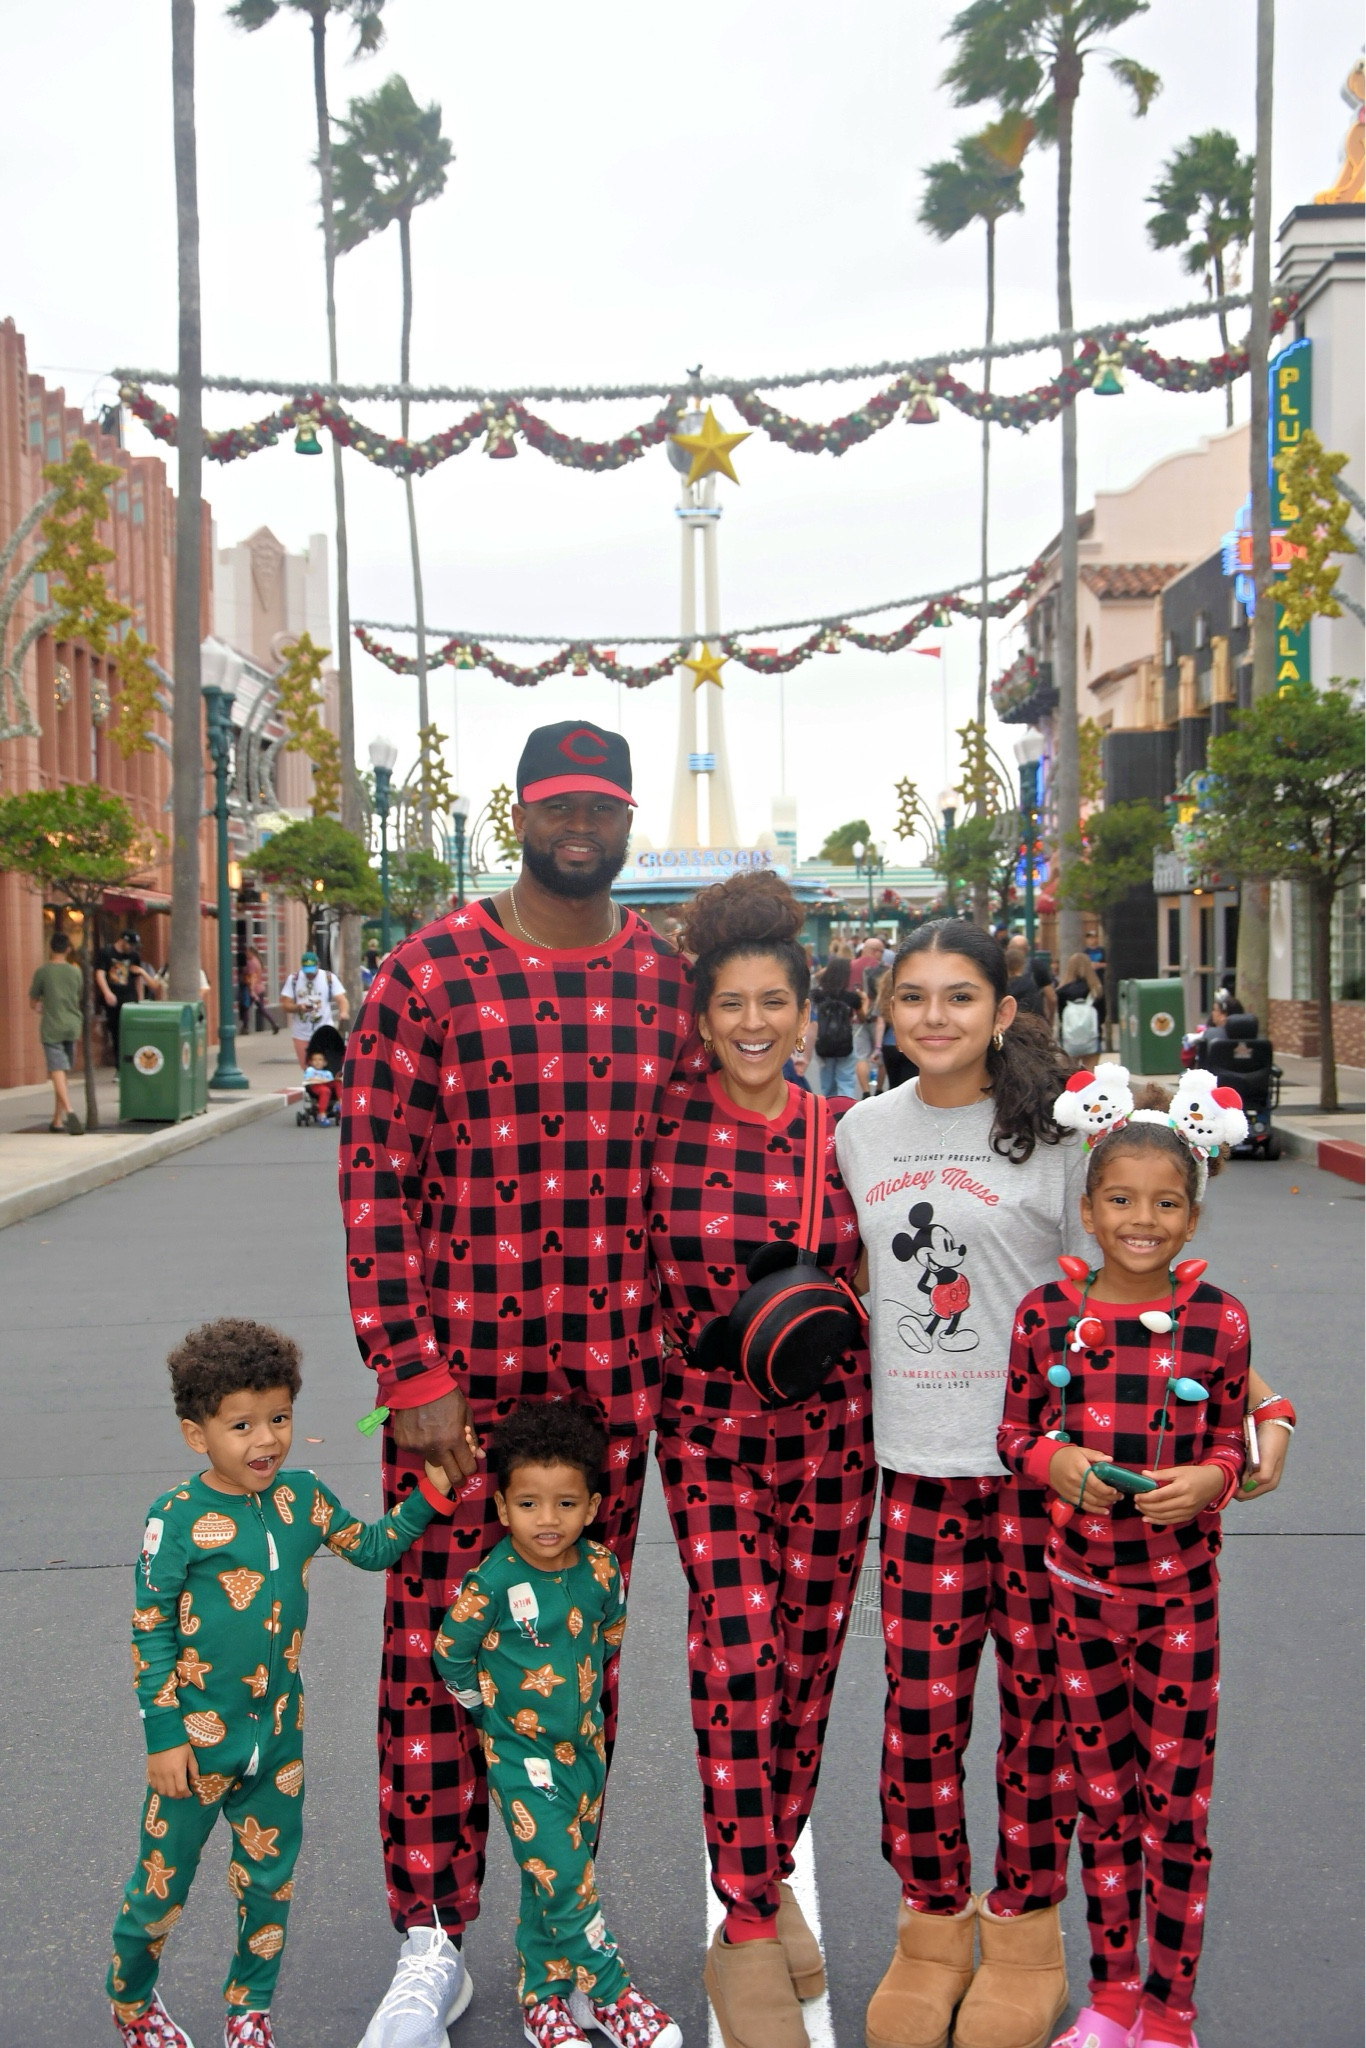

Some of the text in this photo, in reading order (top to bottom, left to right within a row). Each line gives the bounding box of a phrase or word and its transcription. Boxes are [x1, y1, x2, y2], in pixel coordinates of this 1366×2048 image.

[558, 729, 608, 765] C
[636, 850, 773, 867] CROSSROADS
[893, 1154, 992, 1163] WALT DISNEY PRESENTS
[865, 1168, 999, 1206] Mickey Mouse
[887, 1369, 1008, 1379] AN AMERICAN CLASSIC
[947, 1381, 970, 1389] 1928
